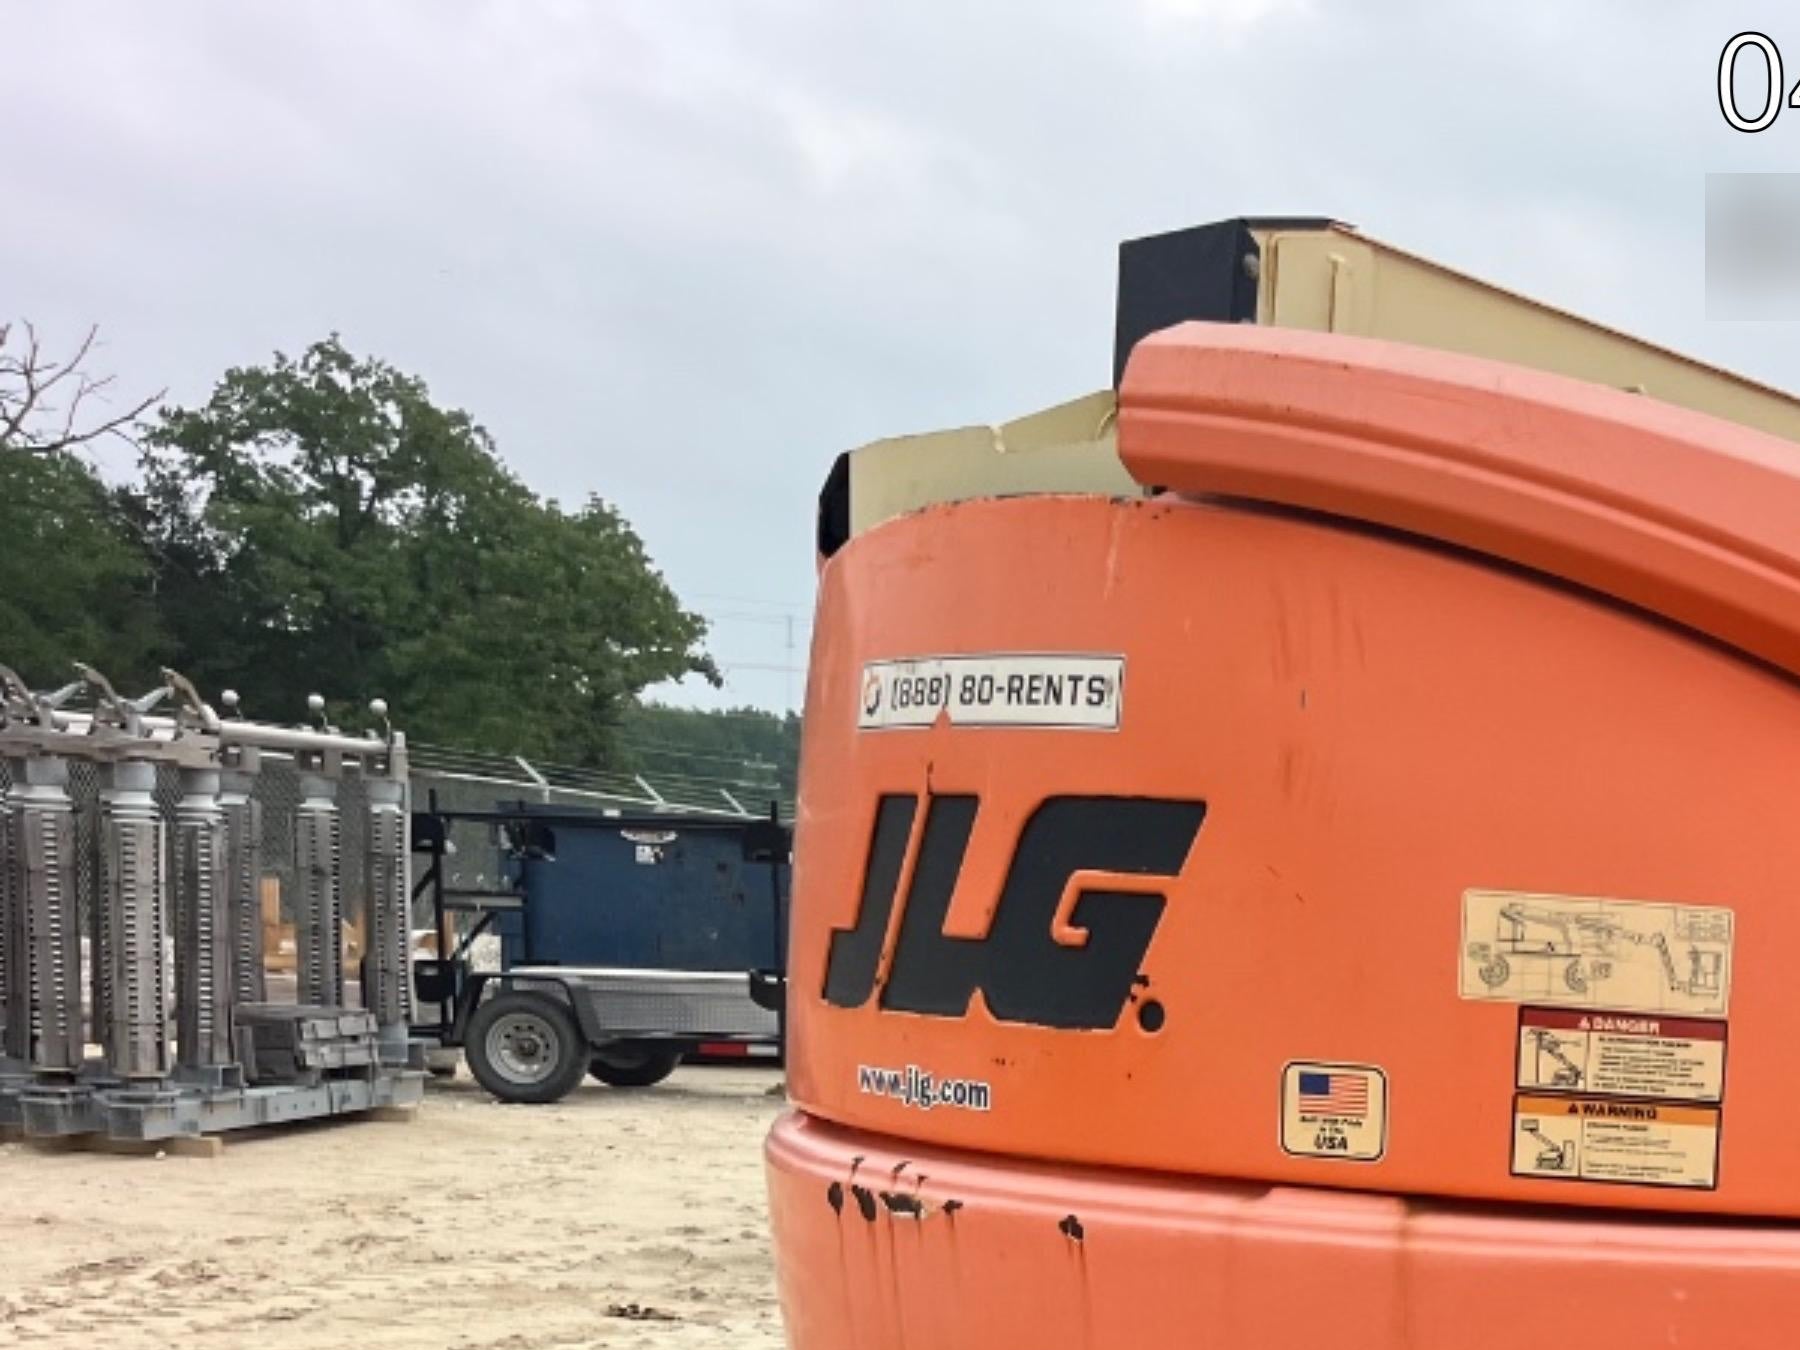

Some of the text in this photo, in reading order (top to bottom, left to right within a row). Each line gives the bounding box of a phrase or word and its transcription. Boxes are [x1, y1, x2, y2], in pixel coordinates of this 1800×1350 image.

[890, 673, 1107, 710] (888) 80-RENTS
[821, 793, 1207, 1032] JLG
[1592, 1014, 1660, 1035] DANGER
[859, 1065, 990, 1109] www.jlg.com
[1583, 1102, 1658, 1121] WARNING
[1314, 1133, 1348, 1151] USA
